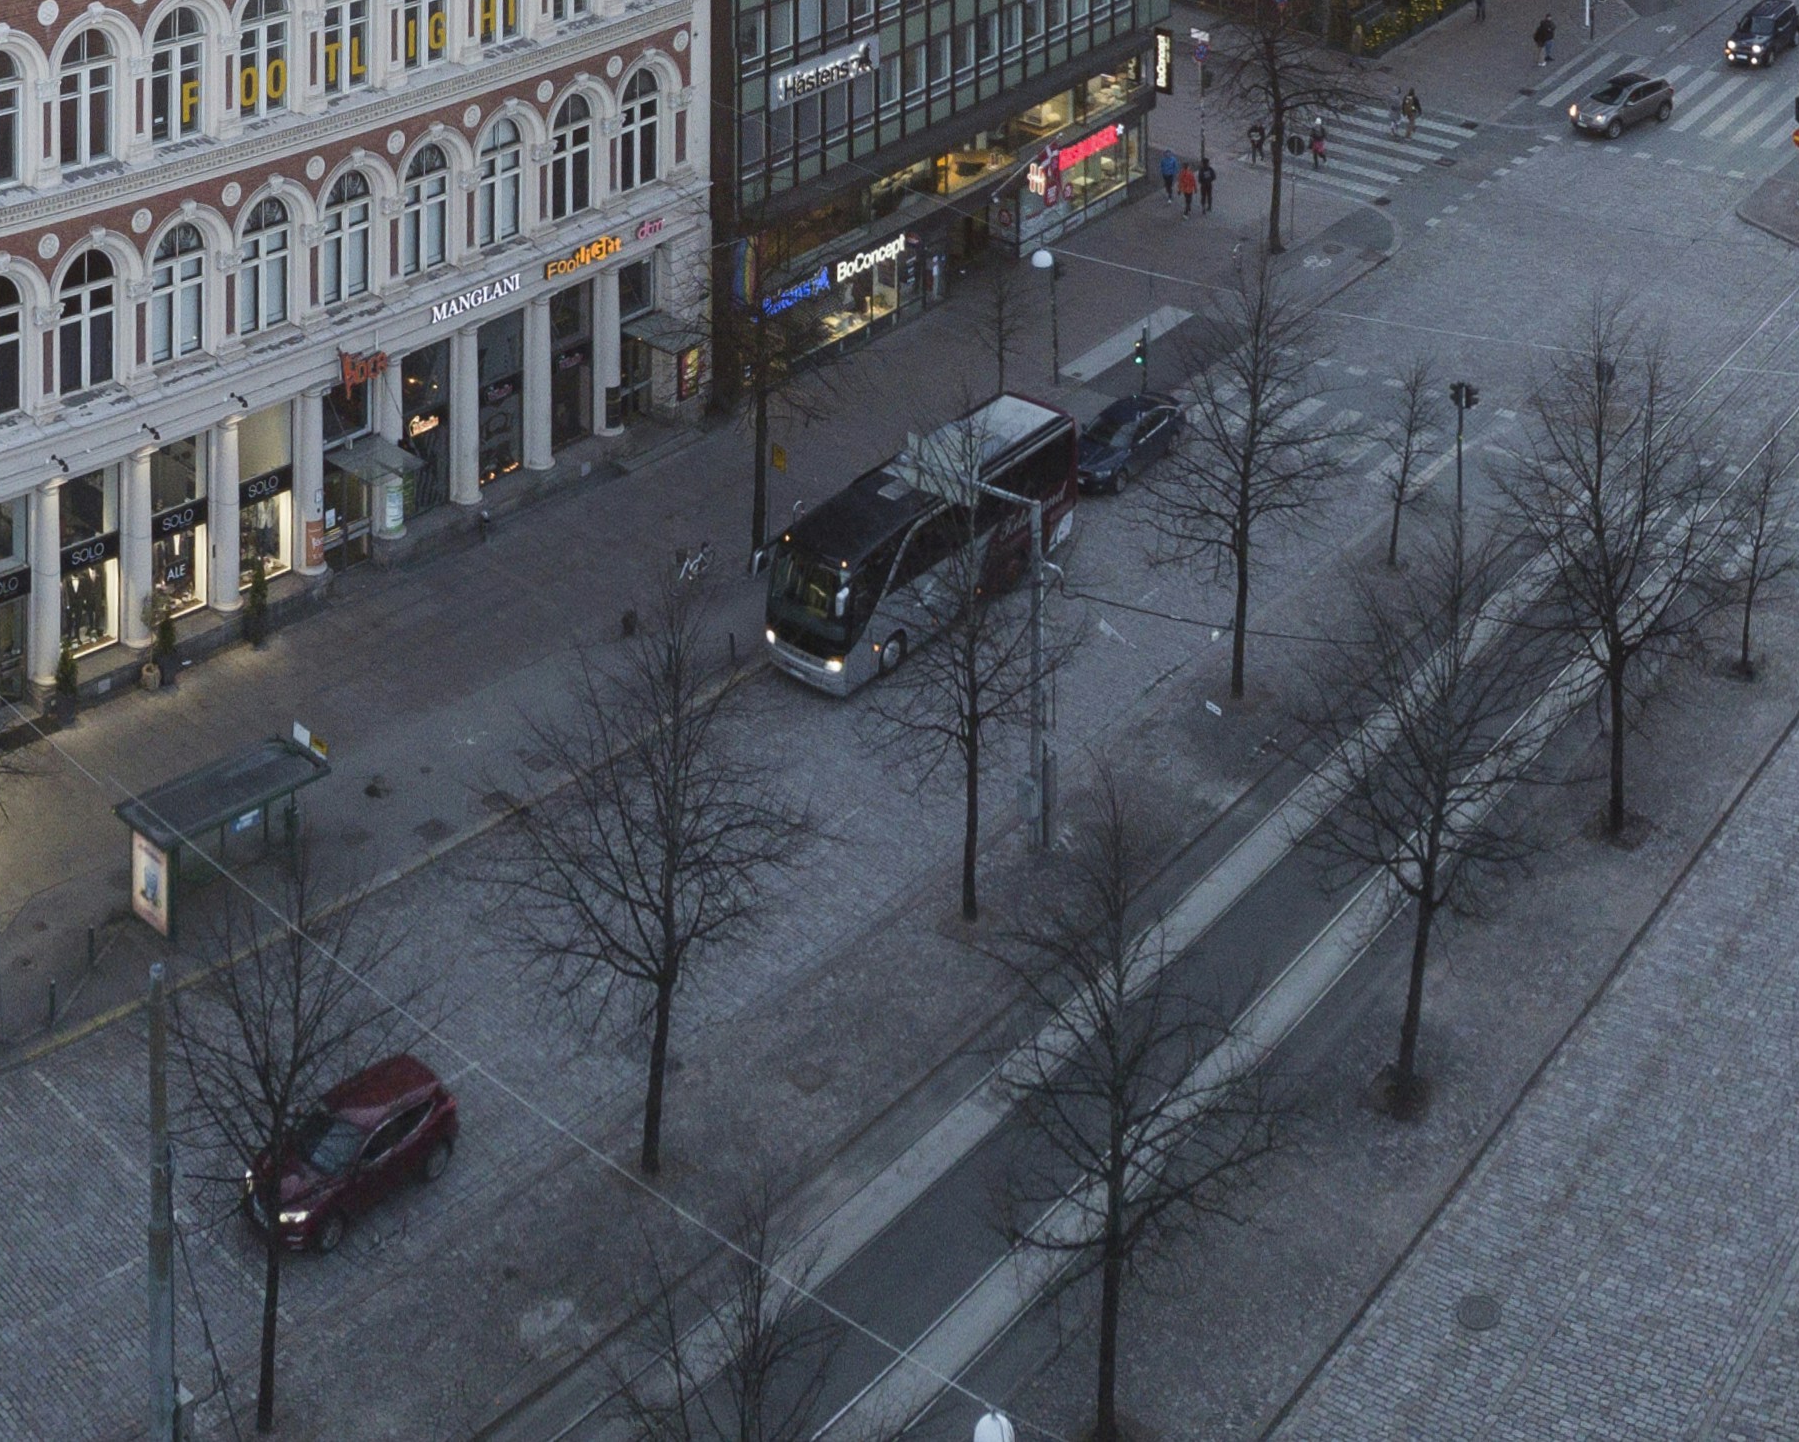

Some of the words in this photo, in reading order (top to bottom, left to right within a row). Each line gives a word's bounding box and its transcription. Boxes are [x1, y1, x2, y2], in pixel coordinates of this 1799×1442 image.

[837, 233, 906, 283] BoConcept
[431, 273, 521, 324] MANGLANI
[248, 474, 280, 498] SOLO
[161, 509, 194, 532] SOLO
[71, 542, 106, 566] SOLO
